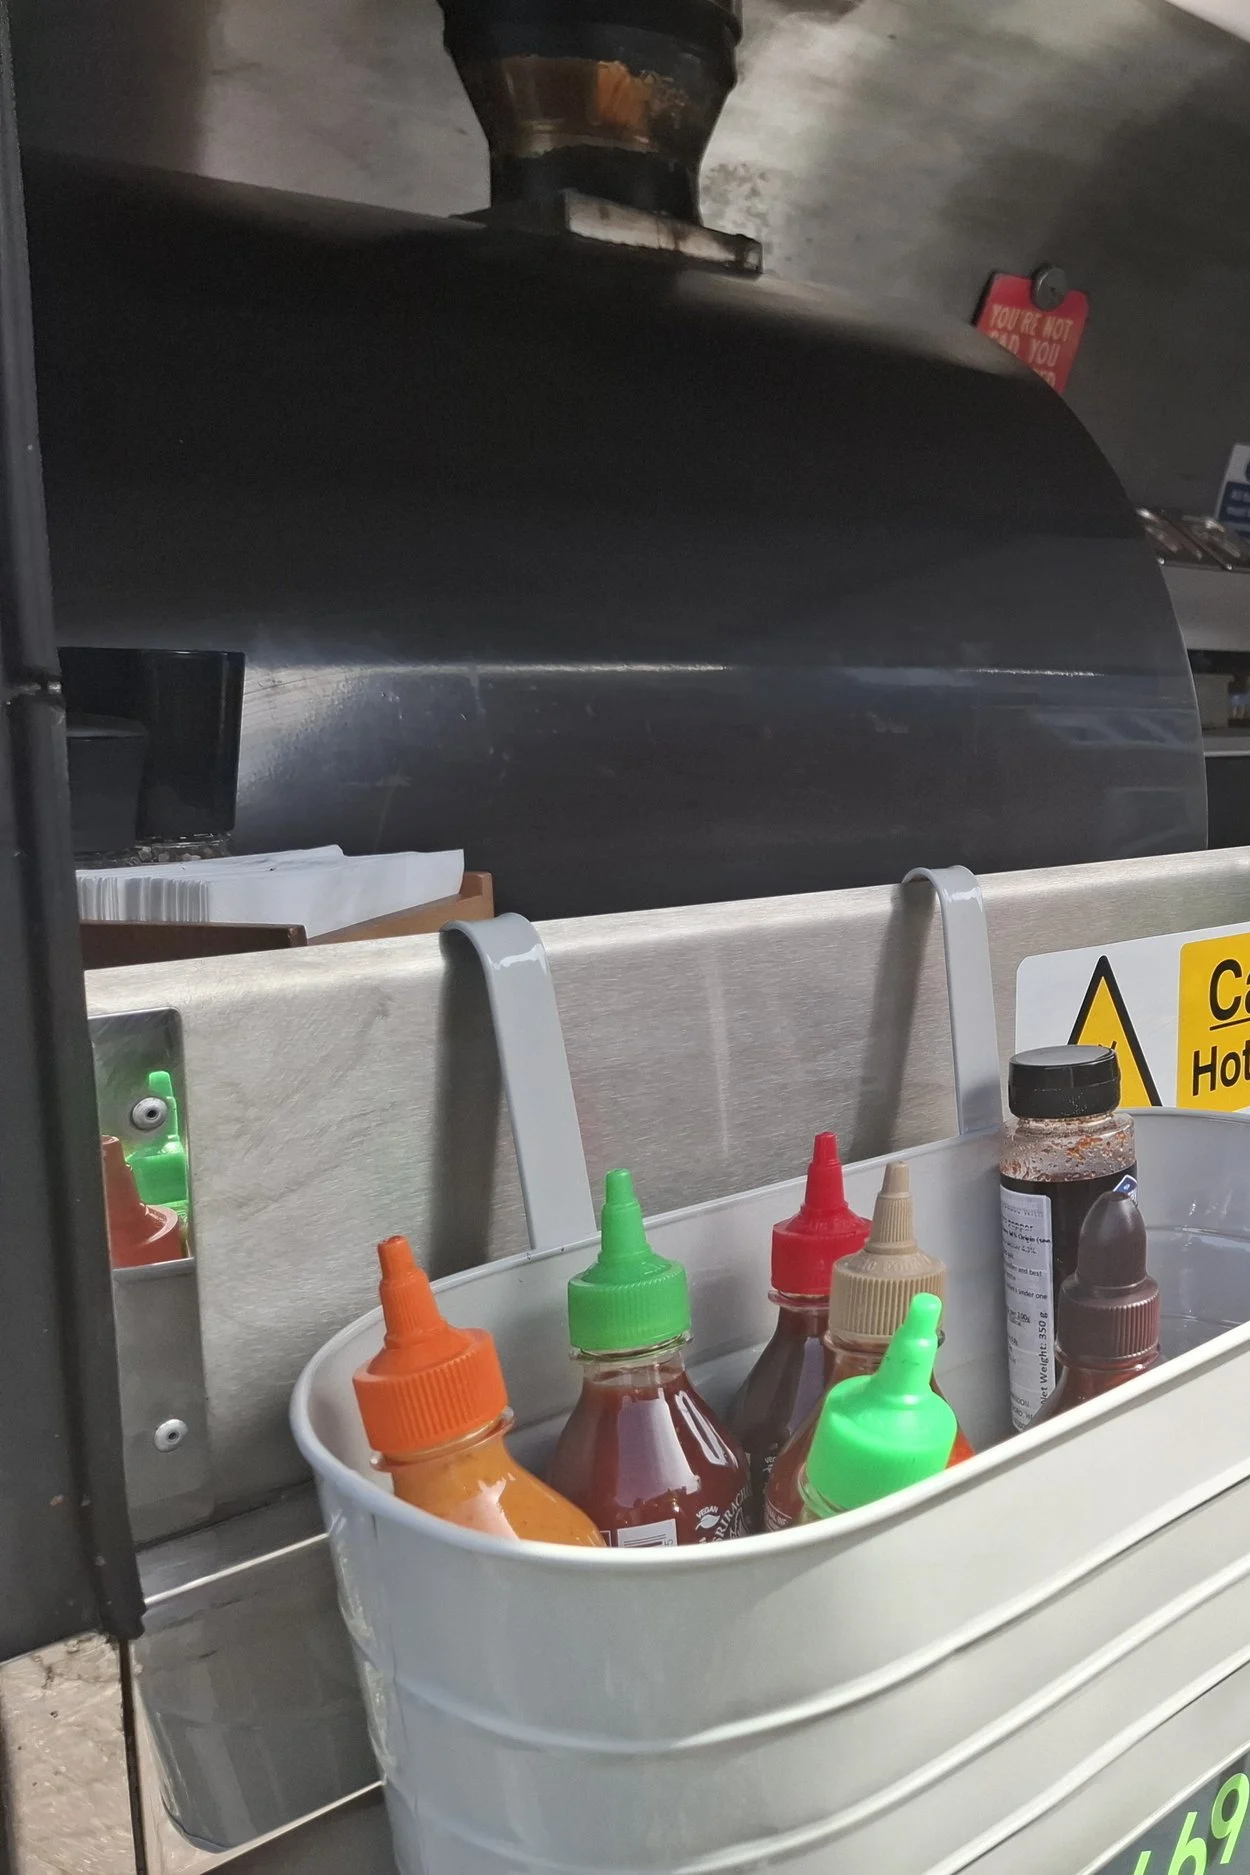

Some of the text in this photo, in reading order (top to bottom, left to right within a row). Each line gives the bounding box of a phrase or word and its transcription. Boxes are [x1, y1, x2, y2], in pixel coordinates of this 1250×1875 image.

[988, 304, 1075, 342] YOU'RE NOT
[1028, 338, 1061, 367] YOU
[1029, 1269, 1042, 1277] best
[1039, 1320, 1047, 1340] 350
[1039, 1343, 1049, 1384] Weight:
[696, 1505, 719, 1519] VEGAN
